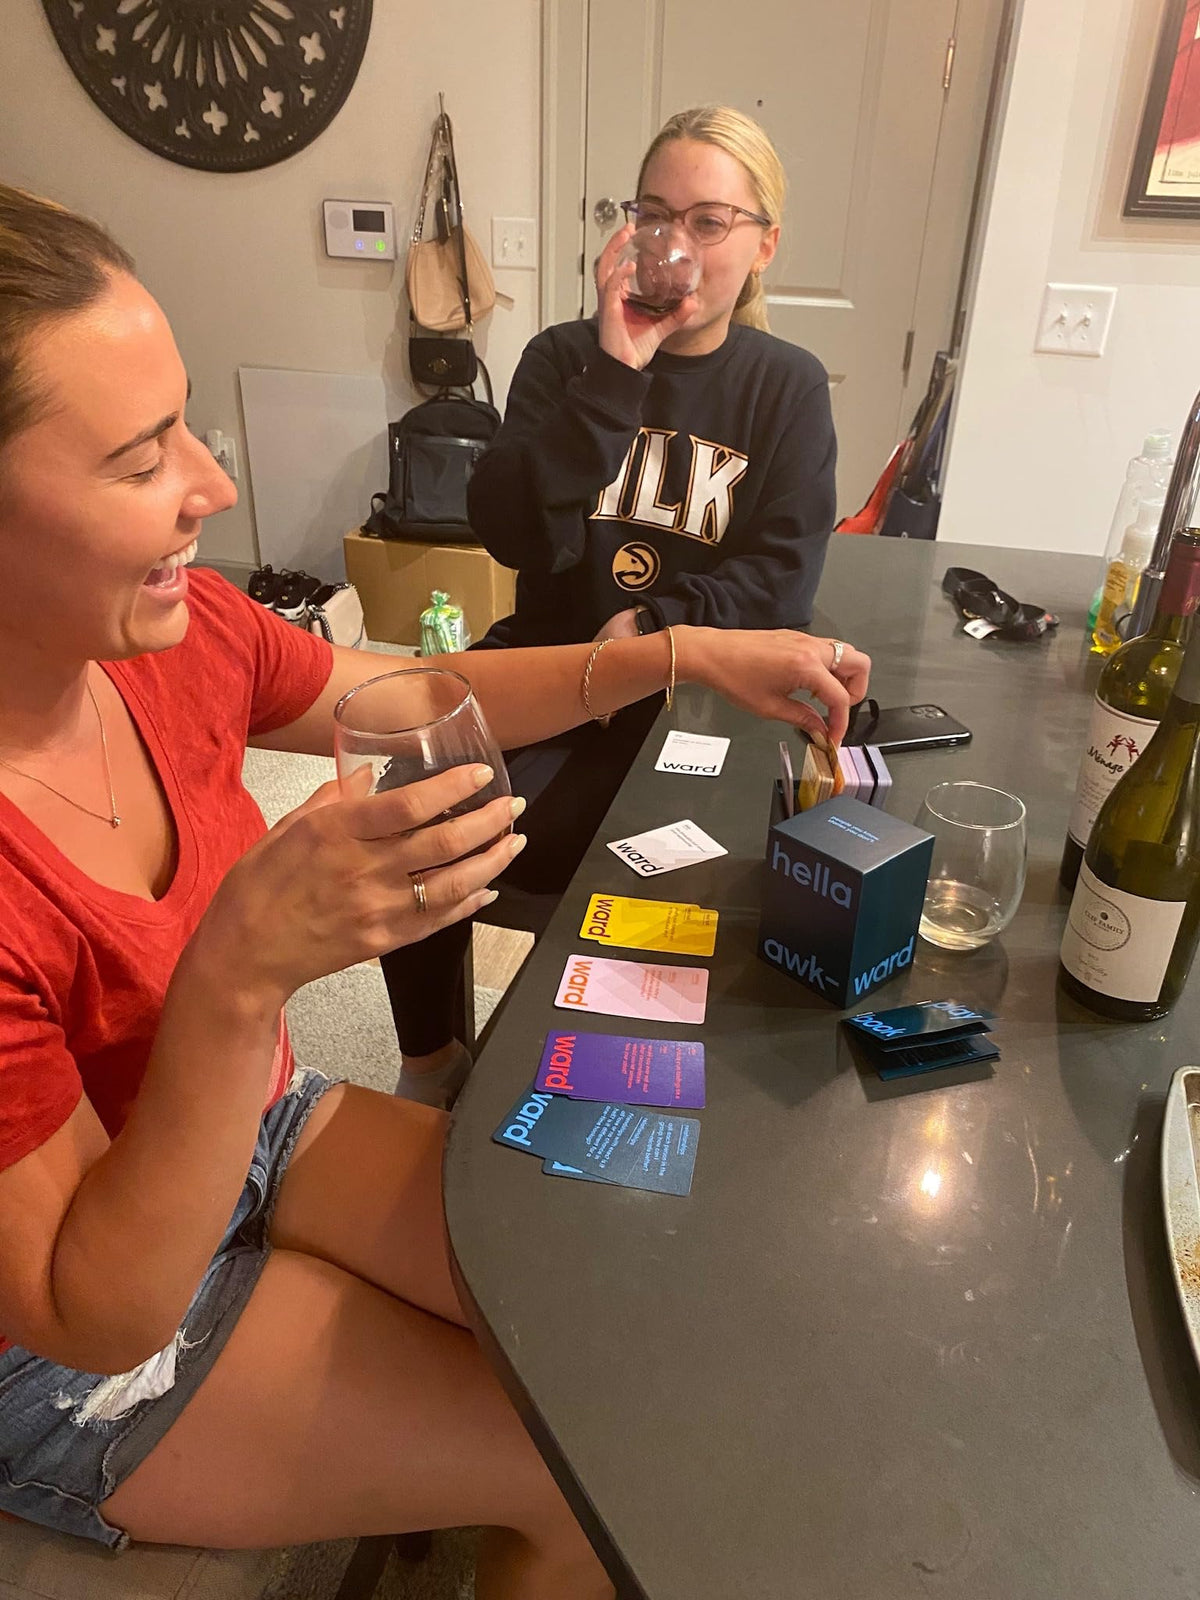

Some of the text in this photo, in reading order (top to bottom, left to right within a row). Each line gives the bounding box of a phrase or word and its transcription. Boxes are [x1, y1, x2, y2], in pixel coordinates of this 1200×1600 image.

[663, 762, 717, 773] ward
[616, 842, 664, 873] ward
[772, 840, 852, 909] hella
[587, 899, 614, 938] ward
[562, 961, 593, 1007] ward
[764, 938, 840, 991] awk-
[854, 935, 915, 995] ward
[851, 1012, 906, 1037] book
[544, 1035, 577, 1090] ward
